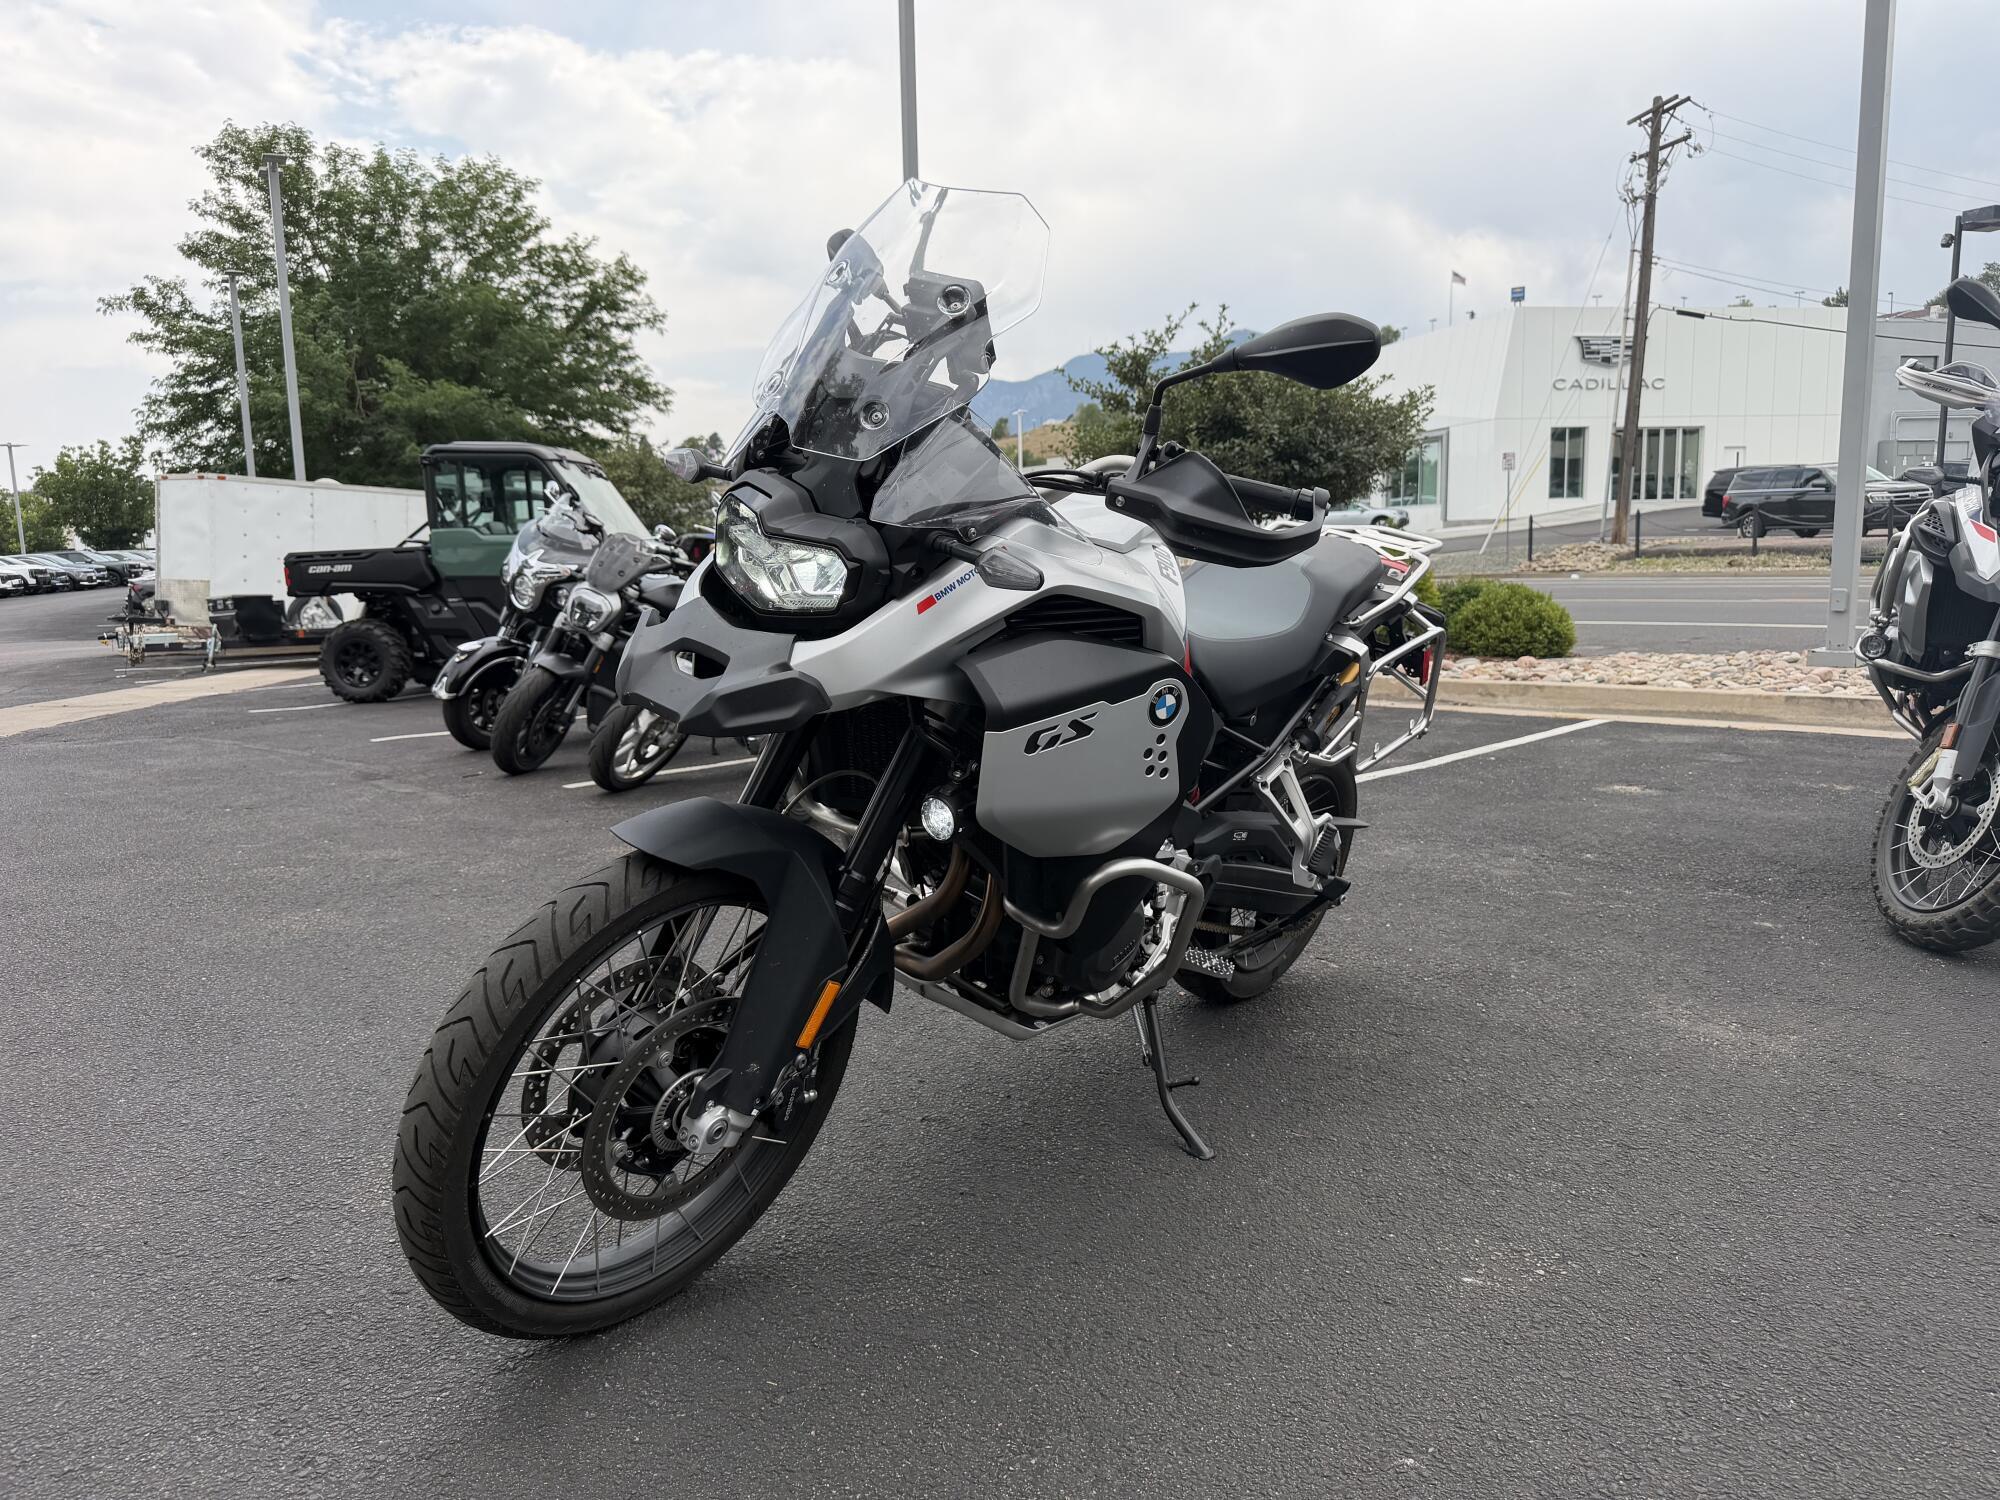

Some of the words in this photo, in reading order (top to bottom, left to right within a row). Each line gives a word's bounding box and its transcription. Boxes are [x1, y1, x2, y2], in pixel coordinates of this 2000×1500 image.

[1552, 378, 1665, 391] CADILLAC
[308, 564, 353, 574] can-am
[934, 581, 957, 601] BMW
[1023, 711, 1100, 756] GS
